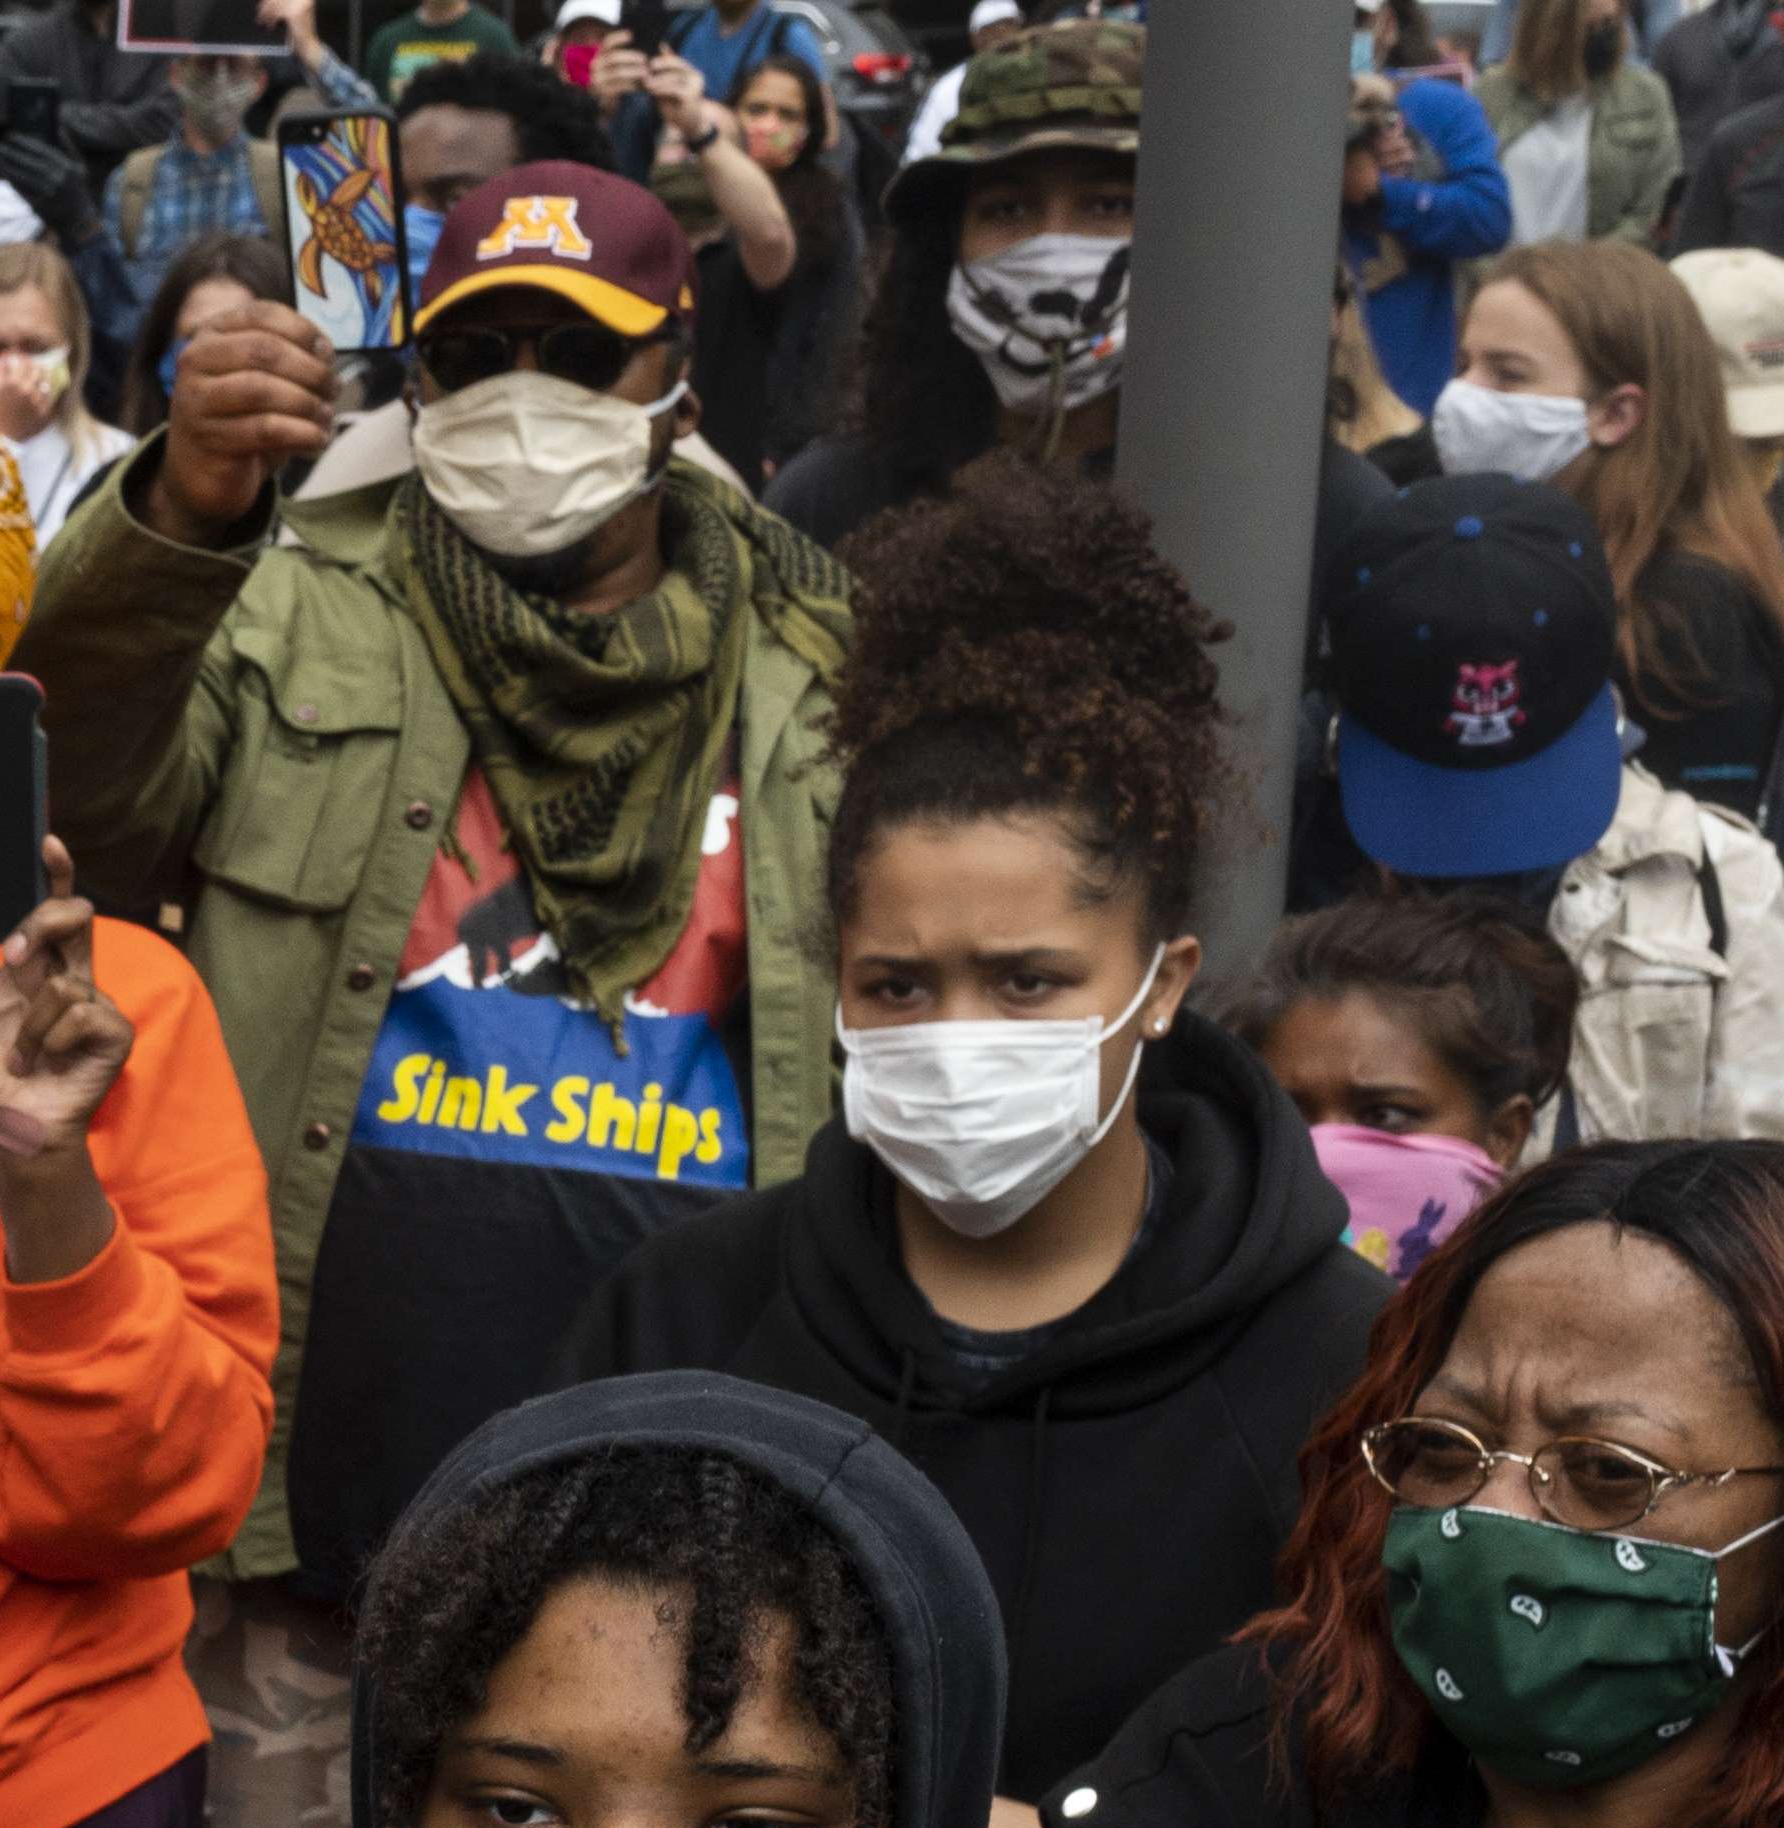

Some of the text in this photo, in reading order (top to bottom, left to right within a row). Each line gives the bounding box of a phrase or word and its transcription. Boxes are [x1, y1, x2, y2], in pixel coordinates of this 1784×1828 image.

[476, 195, 593, 261] M
[377, 1053, 723, 1181] Sink Ships
